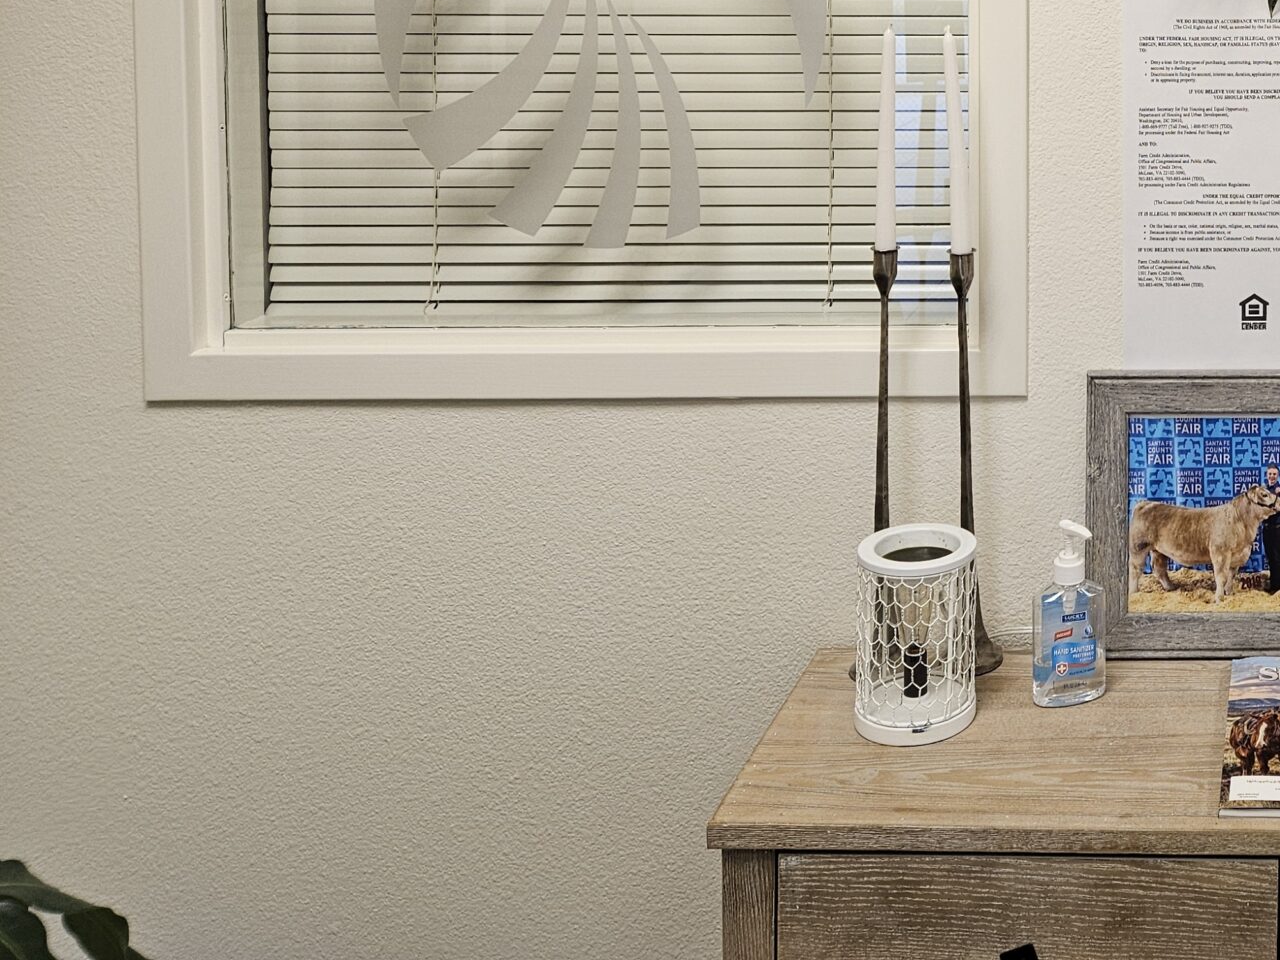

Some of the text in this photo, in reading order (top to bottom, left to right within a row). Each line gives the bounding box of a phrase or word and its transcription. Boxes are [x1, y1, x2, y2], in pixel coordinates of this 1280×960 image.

[1175, 424, 1201, 434] FAIR
[1234, 423, 1259, 434] FAIR
[1148, 454, 1173, 464] FAIR
[1205, 454, 1230, 464] FAIR
[1129, 484, 1145, 494] AIR
[1177, 484, 1202, 494] FAIR
[1054, 645, 1094, 656] HAND SANITIZER
